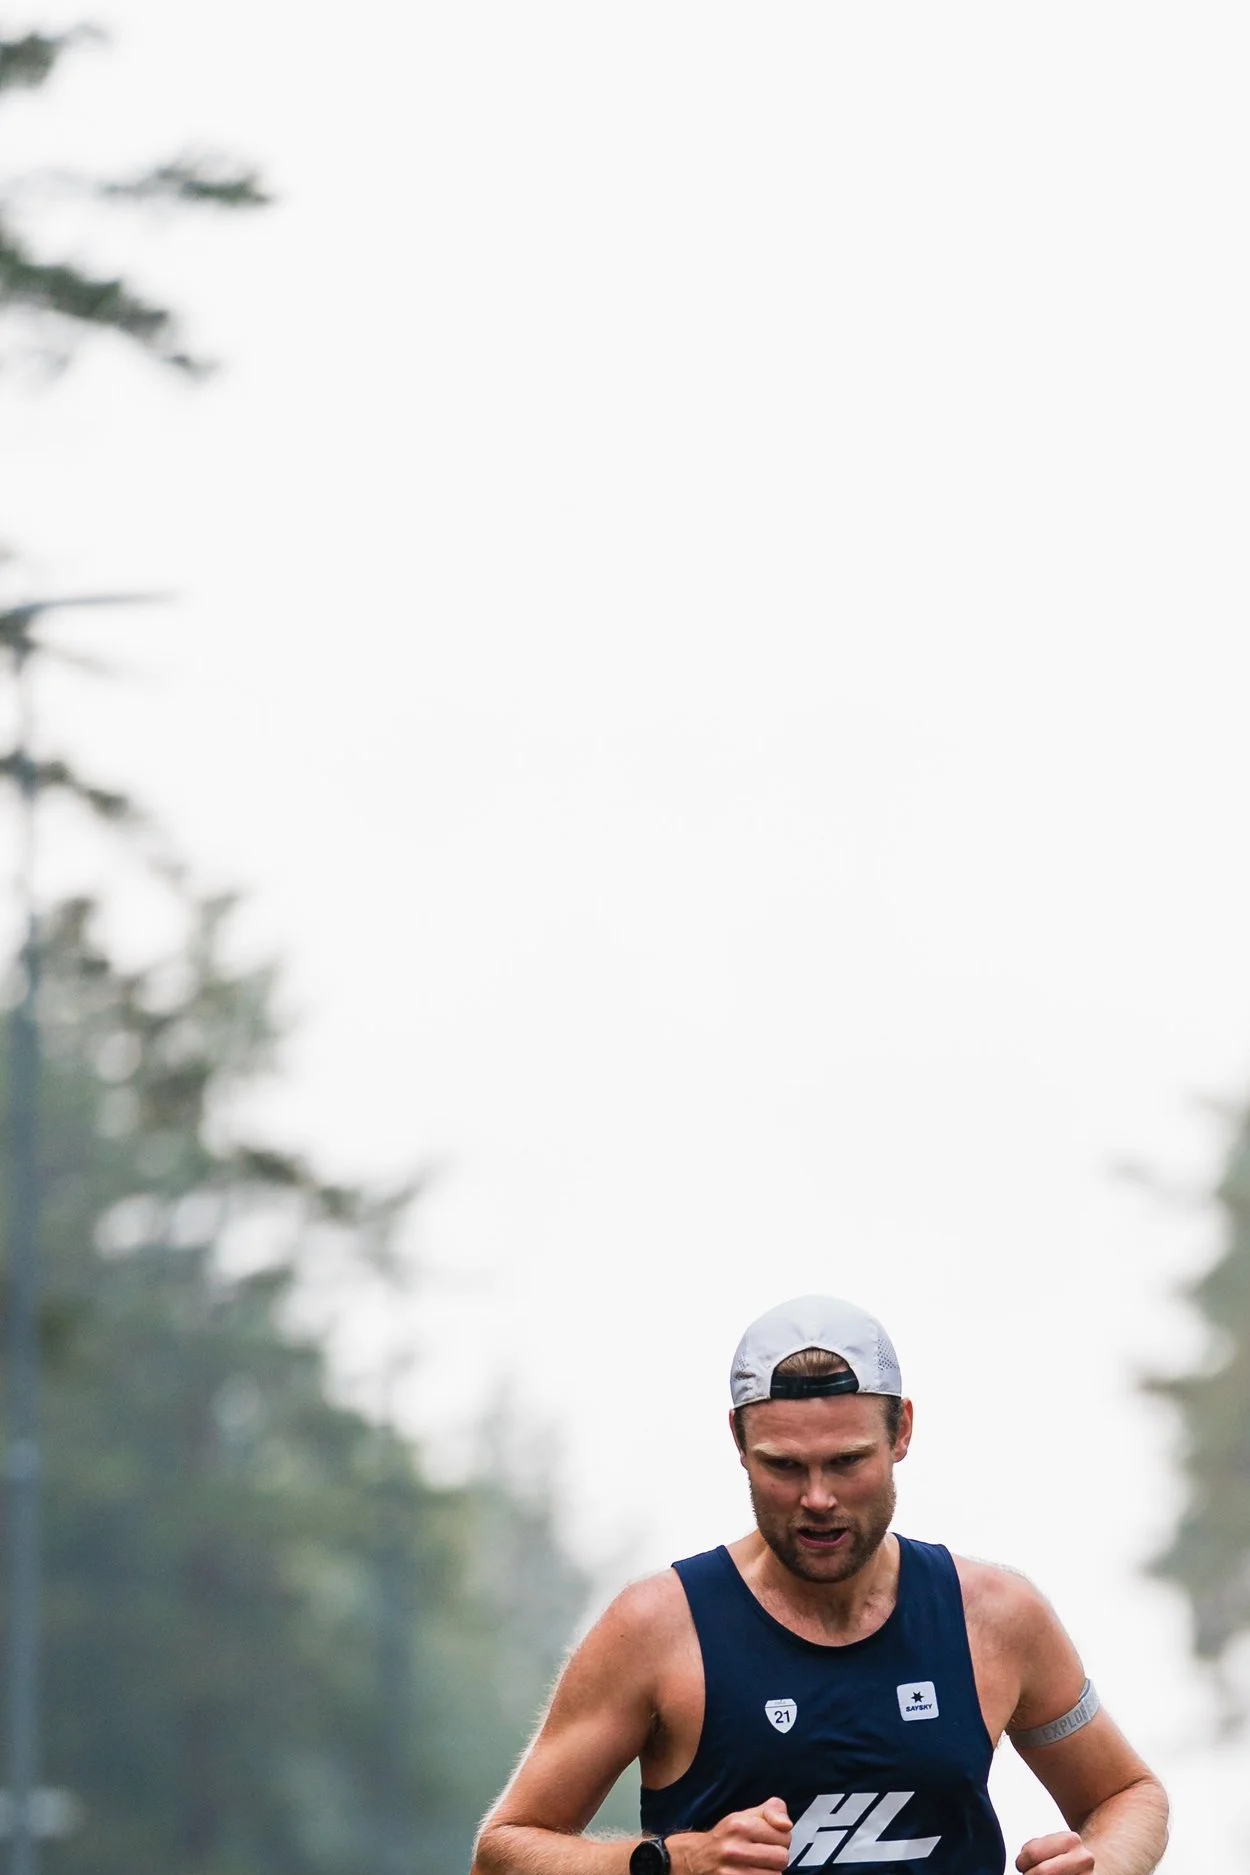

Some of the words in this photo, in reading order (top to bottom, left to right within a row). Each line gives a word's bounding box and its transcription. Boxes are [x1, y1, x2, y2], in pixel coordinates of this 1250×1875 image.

[905, 1703, 933, 1713] SAYSKY
[774, 1710, 791, 1724] 21
[1041, 1703, 1089, 1741] EXPLOR
